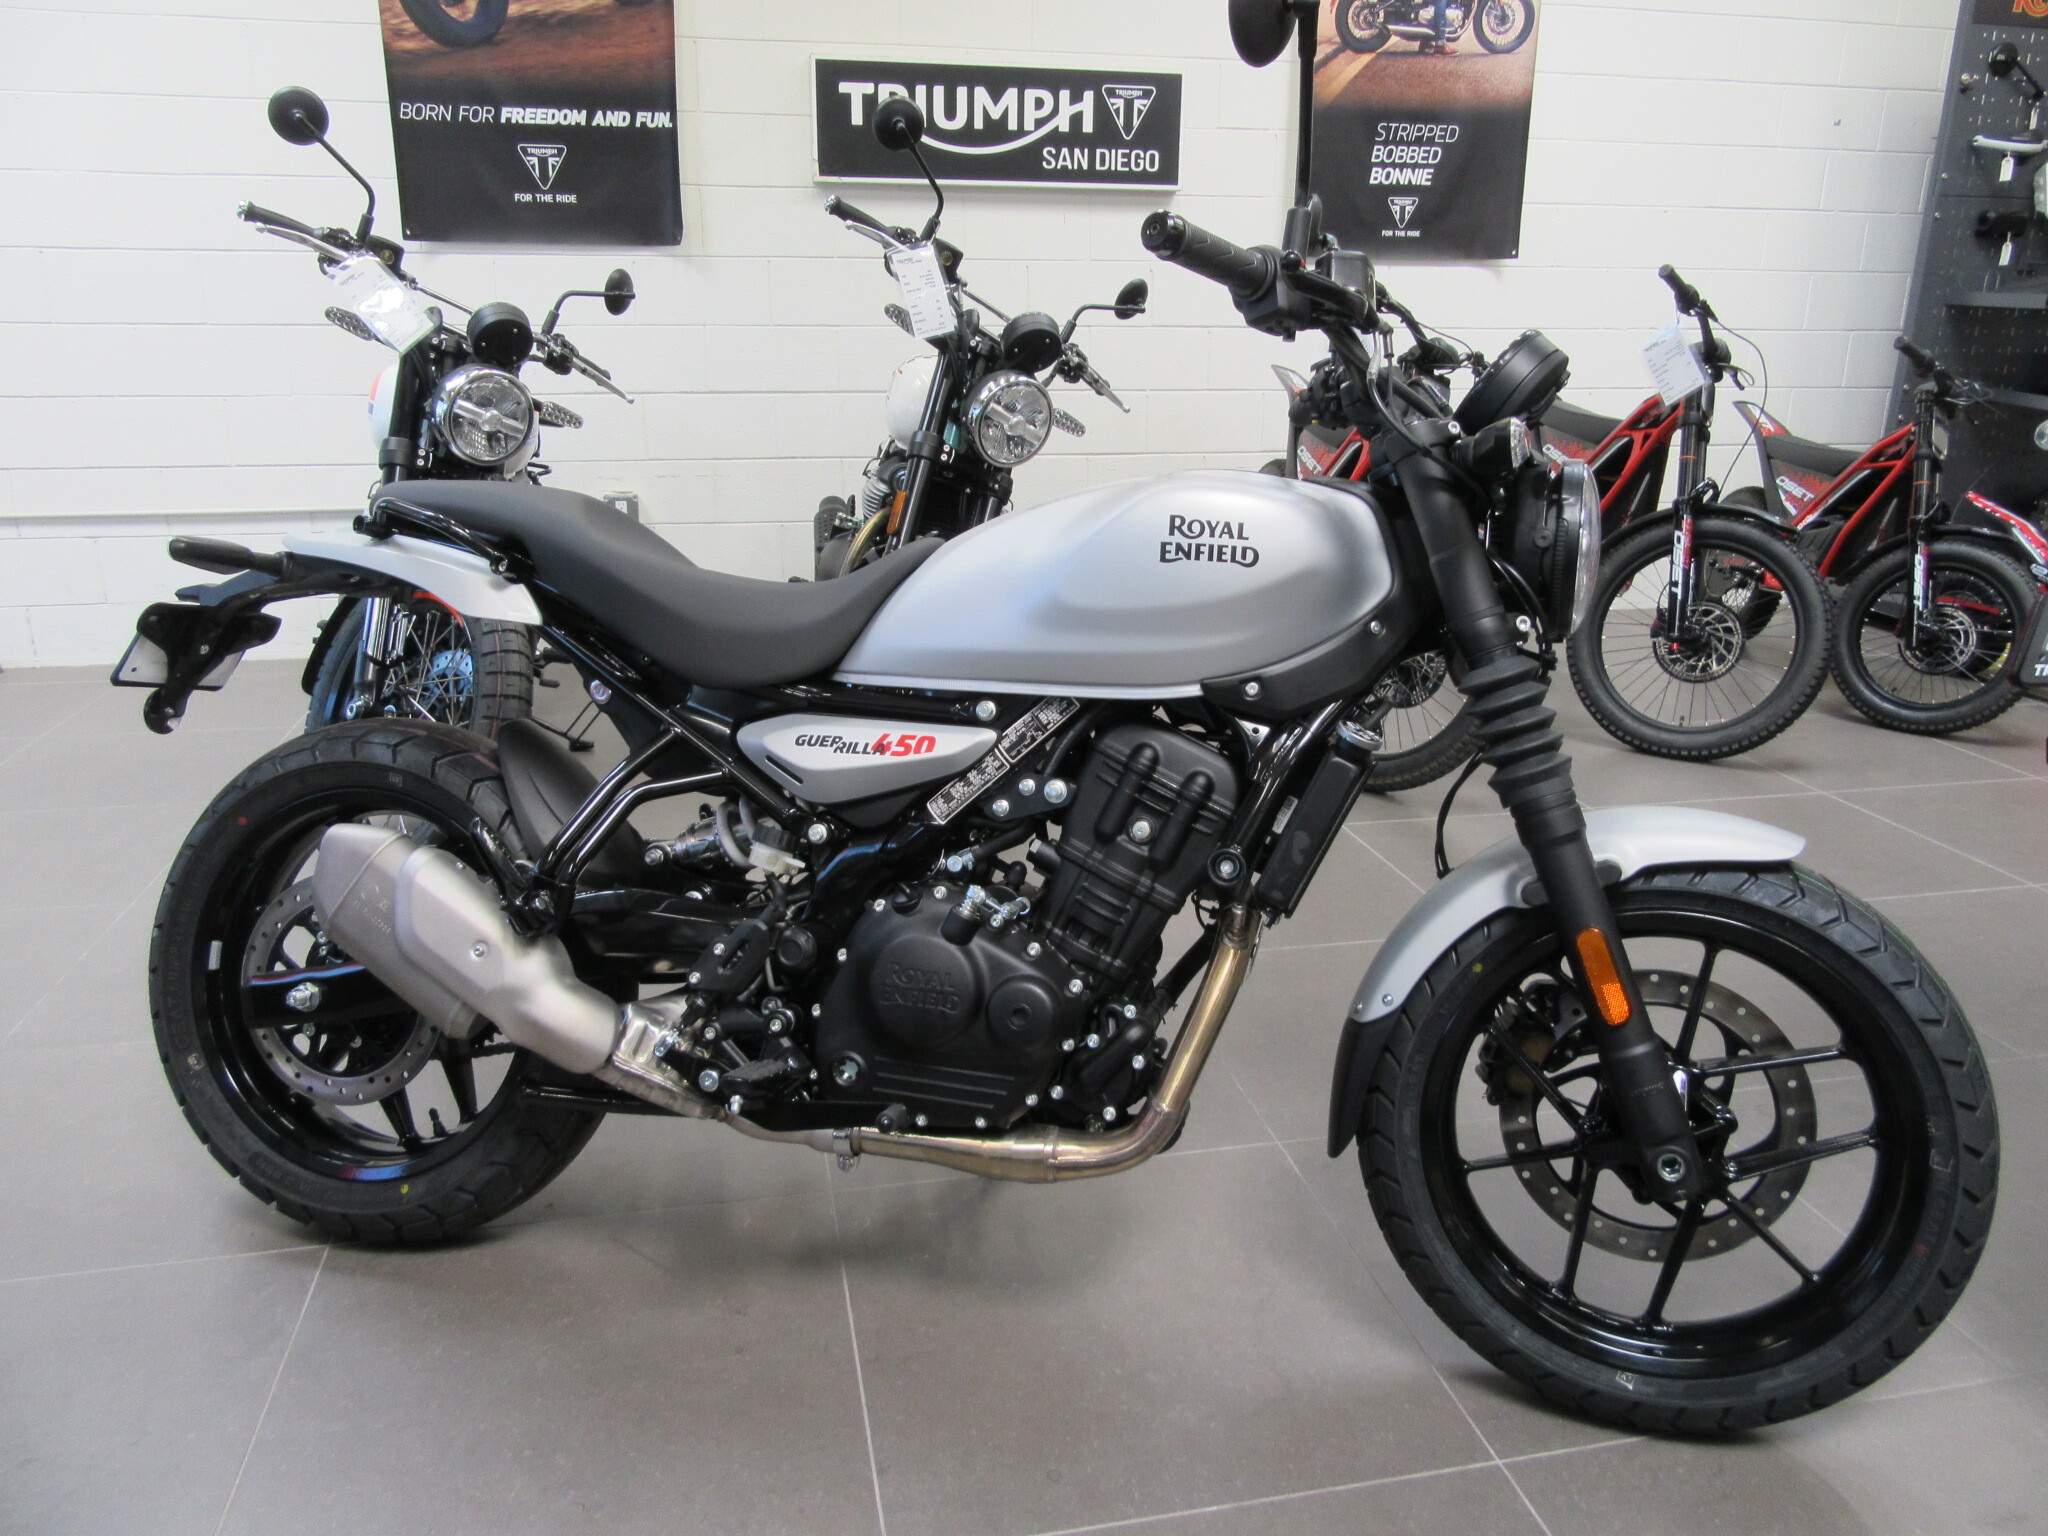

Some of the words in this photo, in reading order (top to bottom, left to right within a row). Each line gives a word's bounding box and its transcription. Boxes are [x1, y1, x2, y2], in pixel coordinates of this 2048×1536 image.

[1115, 89, 1143, 97] TRIUMPH
[399, 102, 452, 122] BORN
[458, 105, 494, 123] FOR
[500, 106, 587, 126] FREEDOM
[592, 109, 631, 128] AND
[635, 111, 673, 128] FUN.
[1374, 122, 1459, 143] STRIPPED
[526, 147, 558, 155] TRIUMPH
[1042, 147, 1088, 170] SAN
[1095, 148, 1160, 173] DIEGO
[1370, 145, 1442, 164] BOBBED
[1369, 167, 1435, 186] BONNIE
[514, 193, 533, 202] FOR
[535, 193, 553, 203] THE
[556, 194, 577, 203] RIDE
[1776, 475, 1815, 502] OSET
[1168, 514, 1249, 541] ROYAL
[1159, 541, 1260, 568] ENFIELD
[1671, 529, 1684, 601] OSET
[1913, 553, 1923, 611] OSET
[871, 733, 937, 757] 450
[890, 961, 955, 991] ROYAL
[878, 982, 962, 1015] ENFIELD
